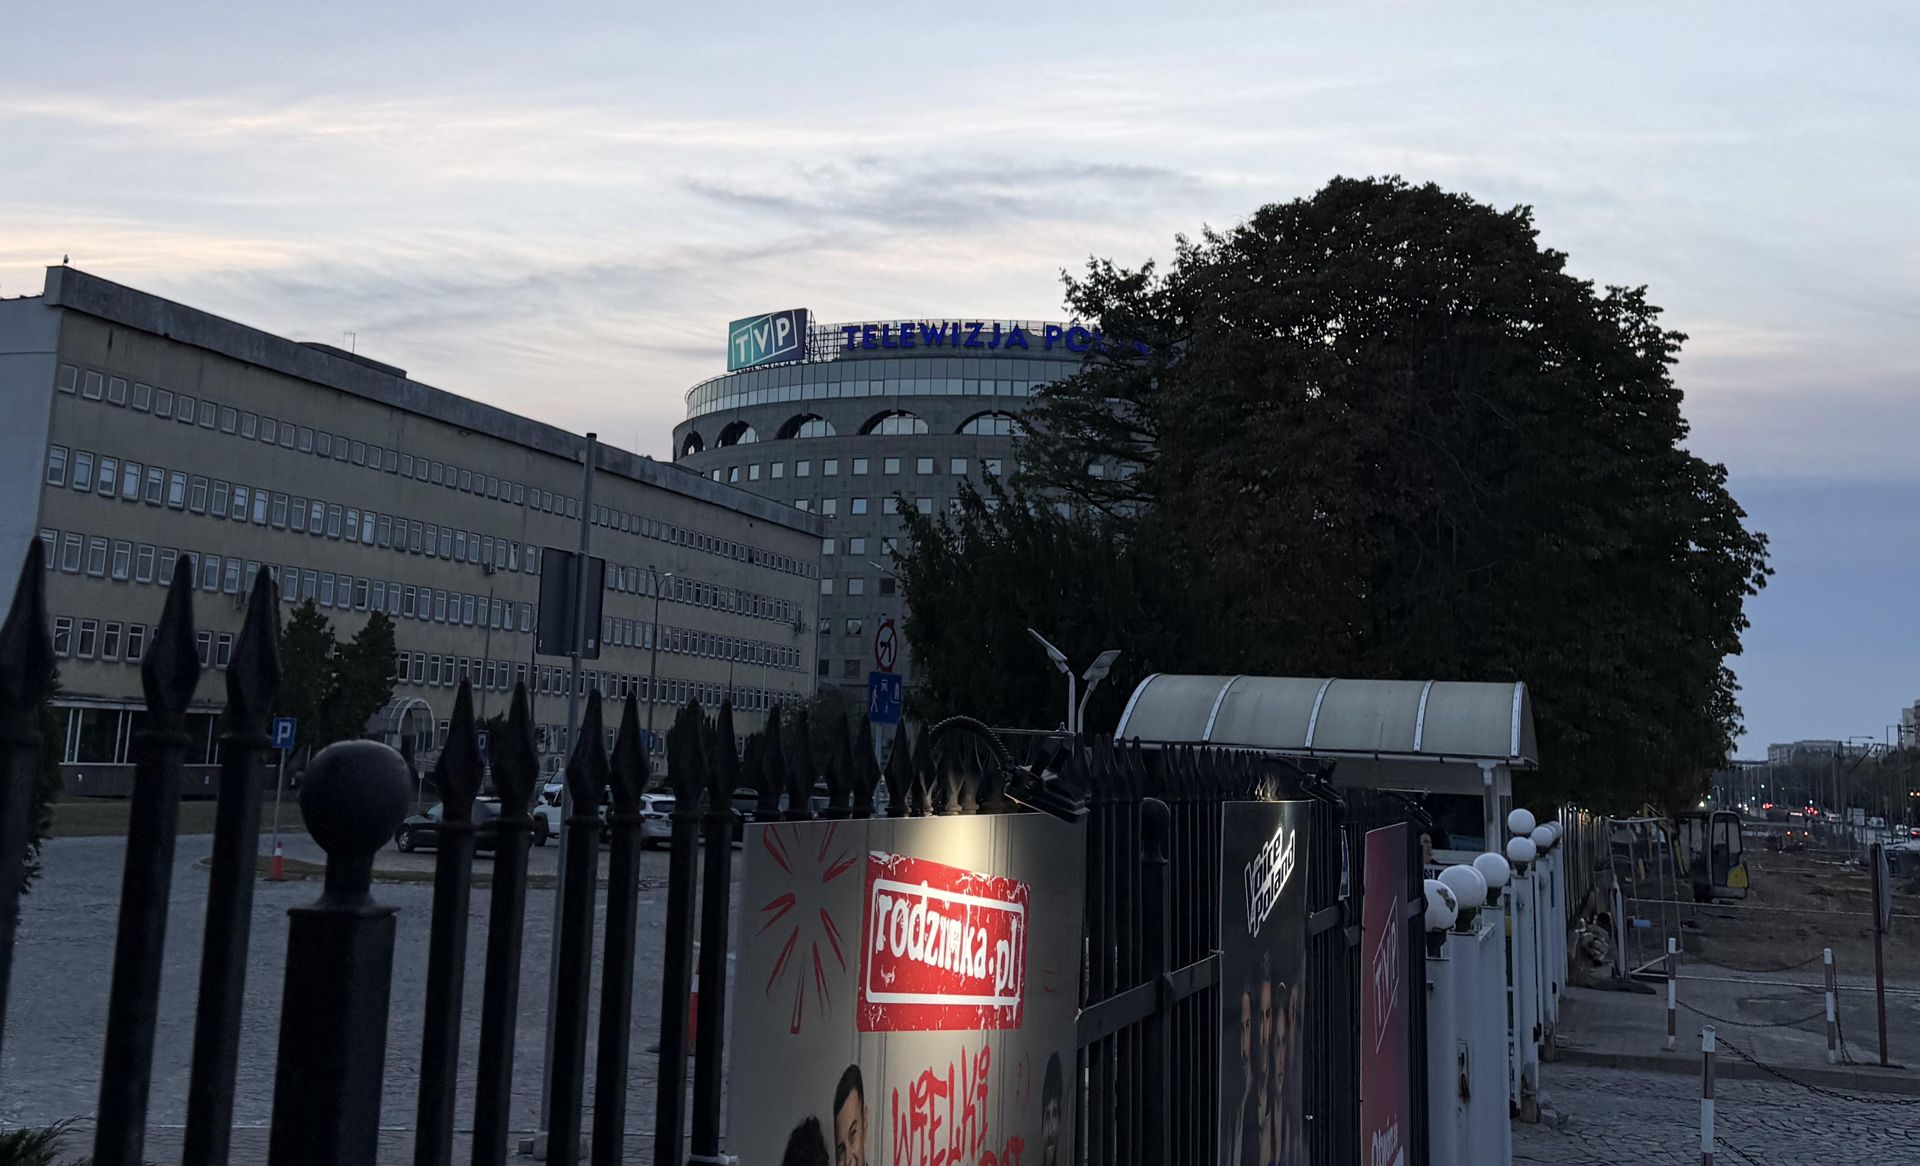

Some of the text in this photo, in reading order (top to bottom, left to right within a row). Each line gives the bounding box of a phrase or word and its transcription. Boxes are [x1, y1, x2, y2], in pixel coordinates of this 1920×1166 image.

[734, 315, 792, 364] TVP
[841, 322, 1029, 351] TELEWIZJA
[276, 721, 292, 744] P
[876, 881, 1018, 1008] rodzinka.pl
